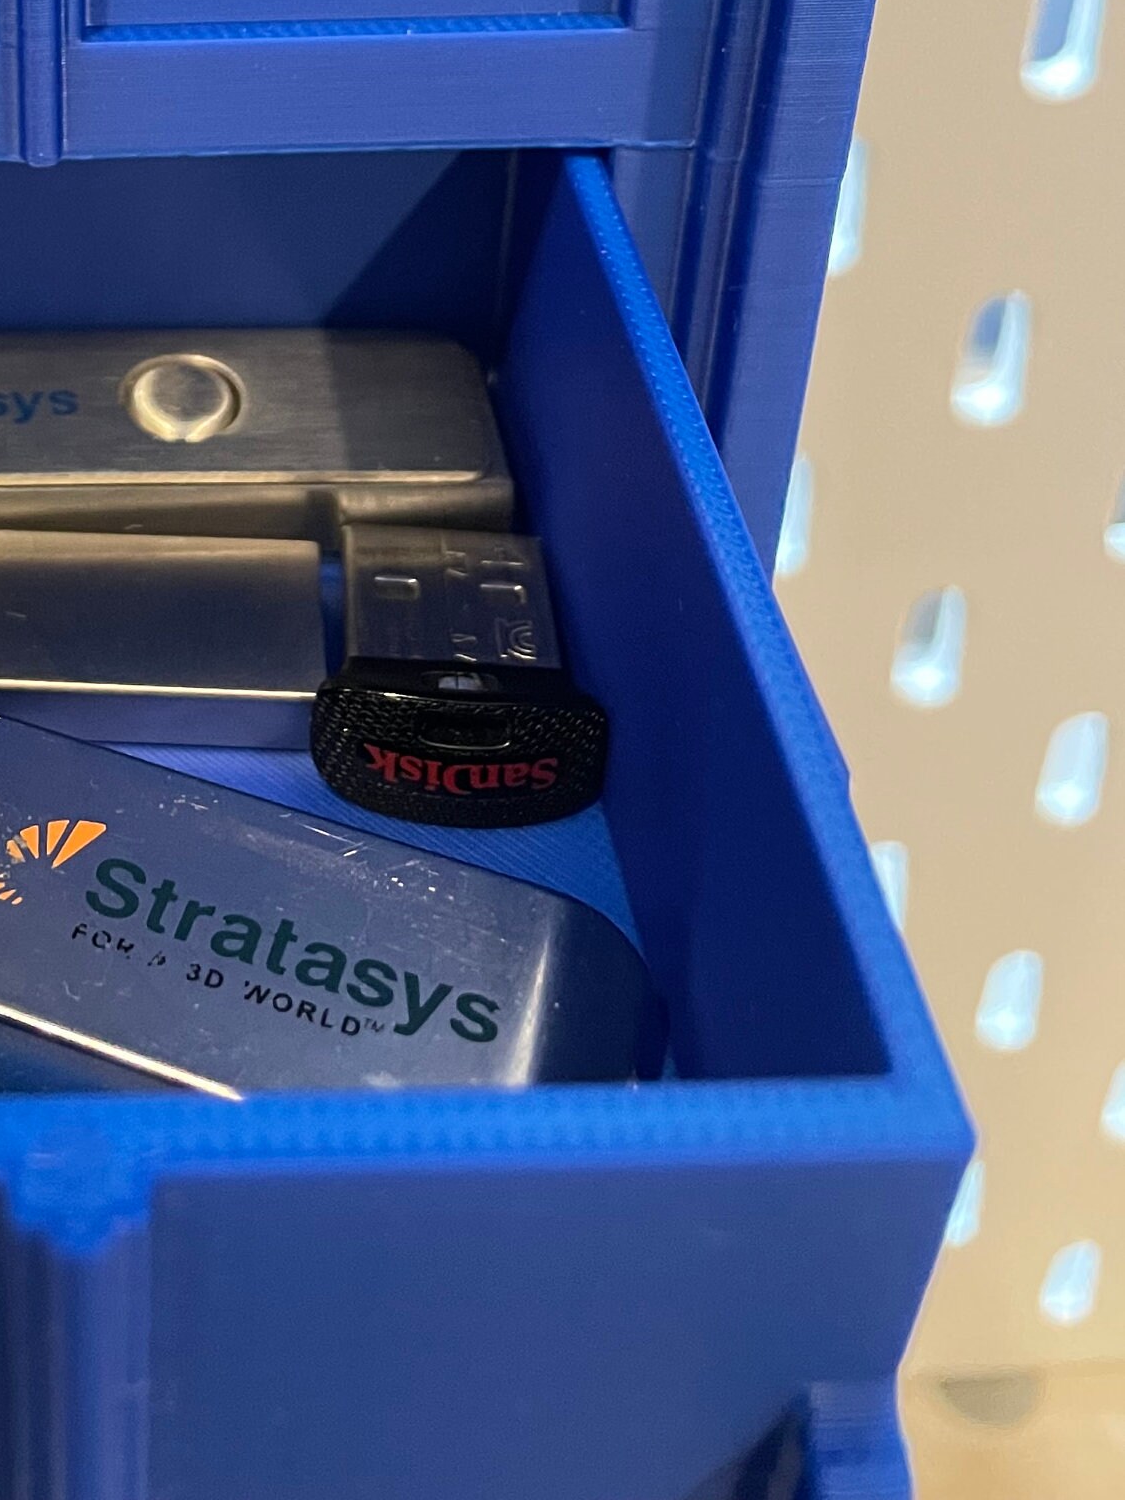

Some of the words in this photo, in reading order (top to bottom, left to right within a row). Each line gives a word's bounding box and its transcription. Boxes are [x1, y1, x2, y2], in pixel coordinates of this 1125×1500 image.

[364, 743, 558, 796] SanDisk
[85, 856, 501, 1044] Stratasys
[186, 963, 225, 989] 3D
